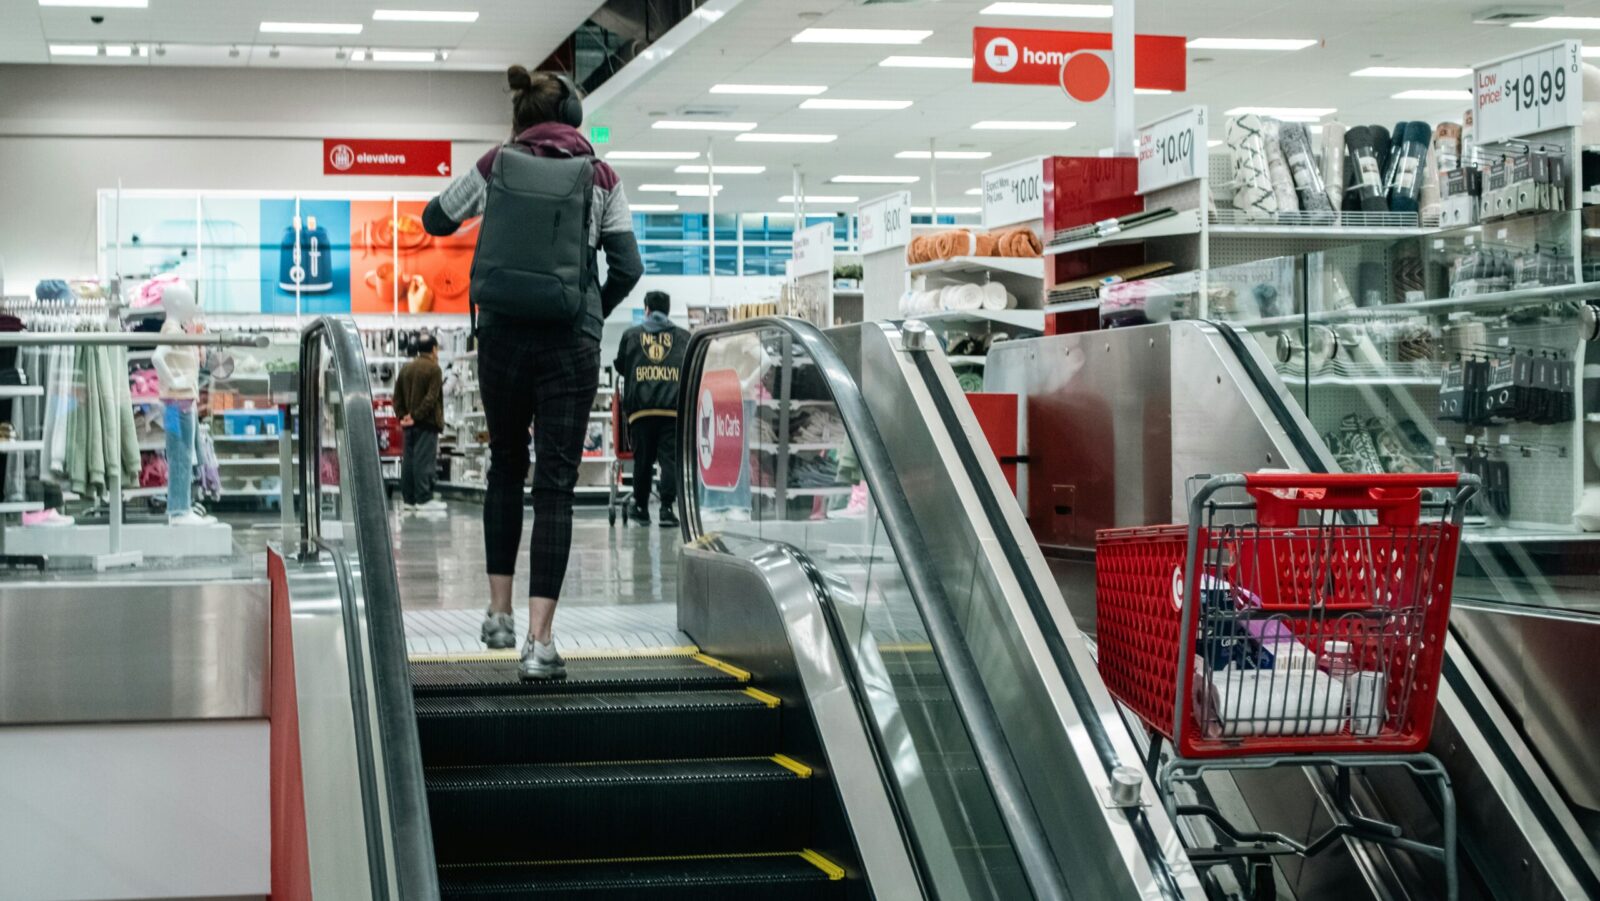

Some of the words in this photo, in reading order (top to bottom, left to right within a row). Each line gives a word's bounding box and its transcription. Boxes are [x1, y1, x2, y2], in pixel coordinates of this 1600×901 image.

[1479, 73, 1497, 88] Low
[1504, 66, 1566, 112] $19.99
[1479, 86, 1503, 110] price!
[356, 151, 406, 165] elevators
[636, 366, 679, 382] BROOKLYN
[716, 414, 725, 437] No
[725, 413, 740, 437] Carts
